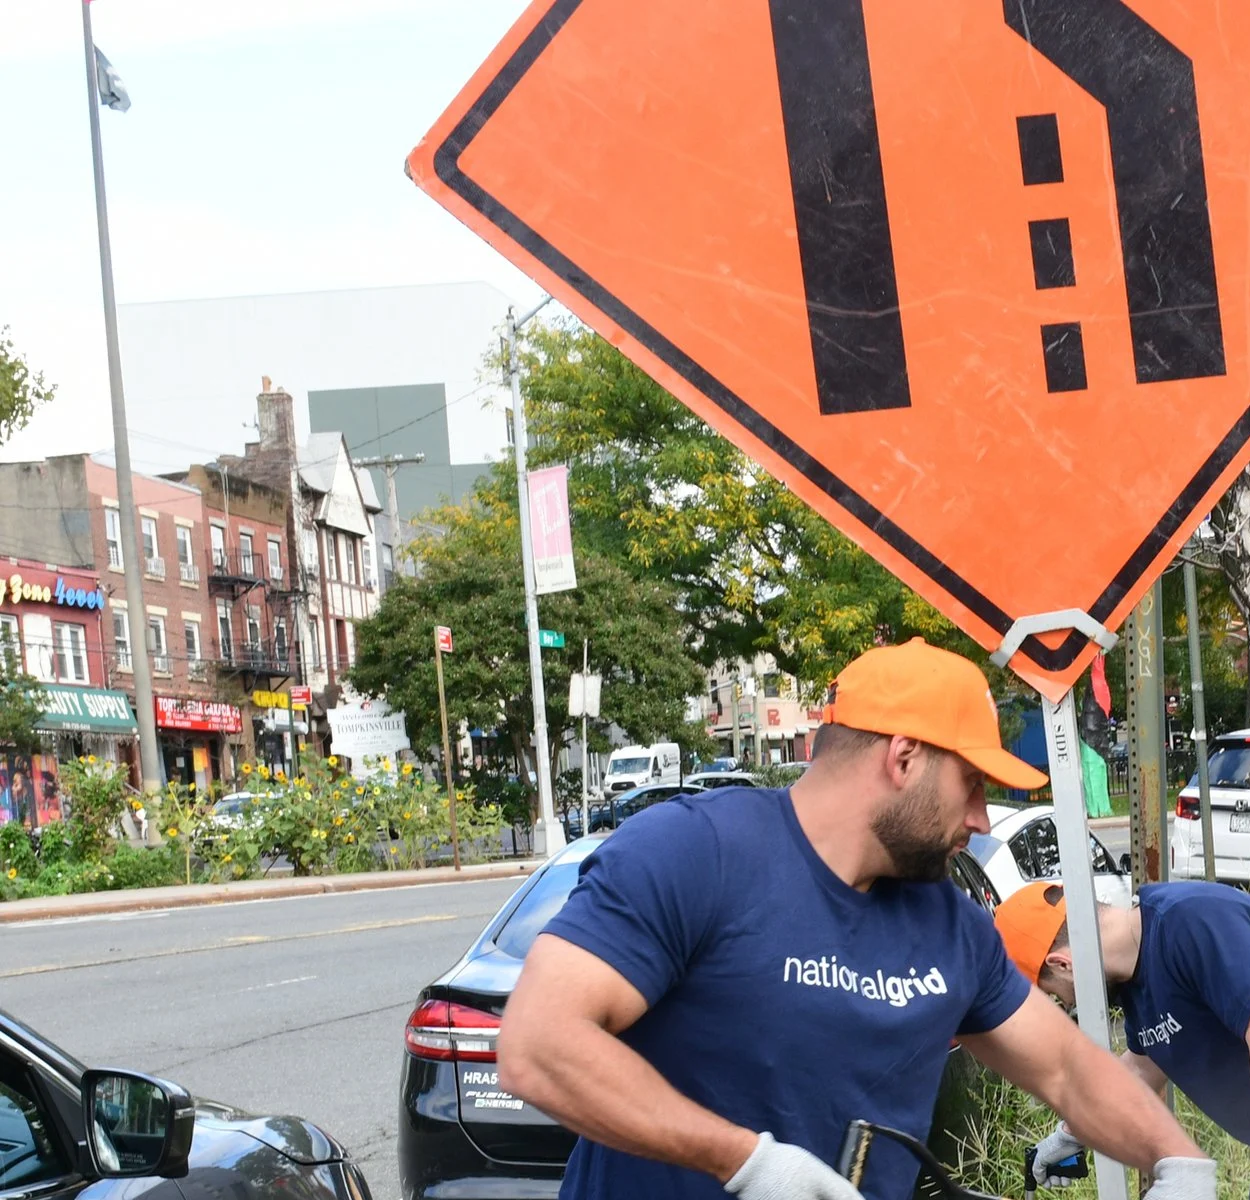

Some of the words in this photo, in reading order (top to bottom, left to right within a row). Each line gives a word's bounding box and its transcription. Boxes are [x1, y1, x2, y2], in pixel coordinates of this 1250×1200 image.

[83, 693, 130, 719] SUPPLY
[336, 719, 402, 734] TOMPKINSVILLE
[1054, 724, 1068, 764] SIDE
